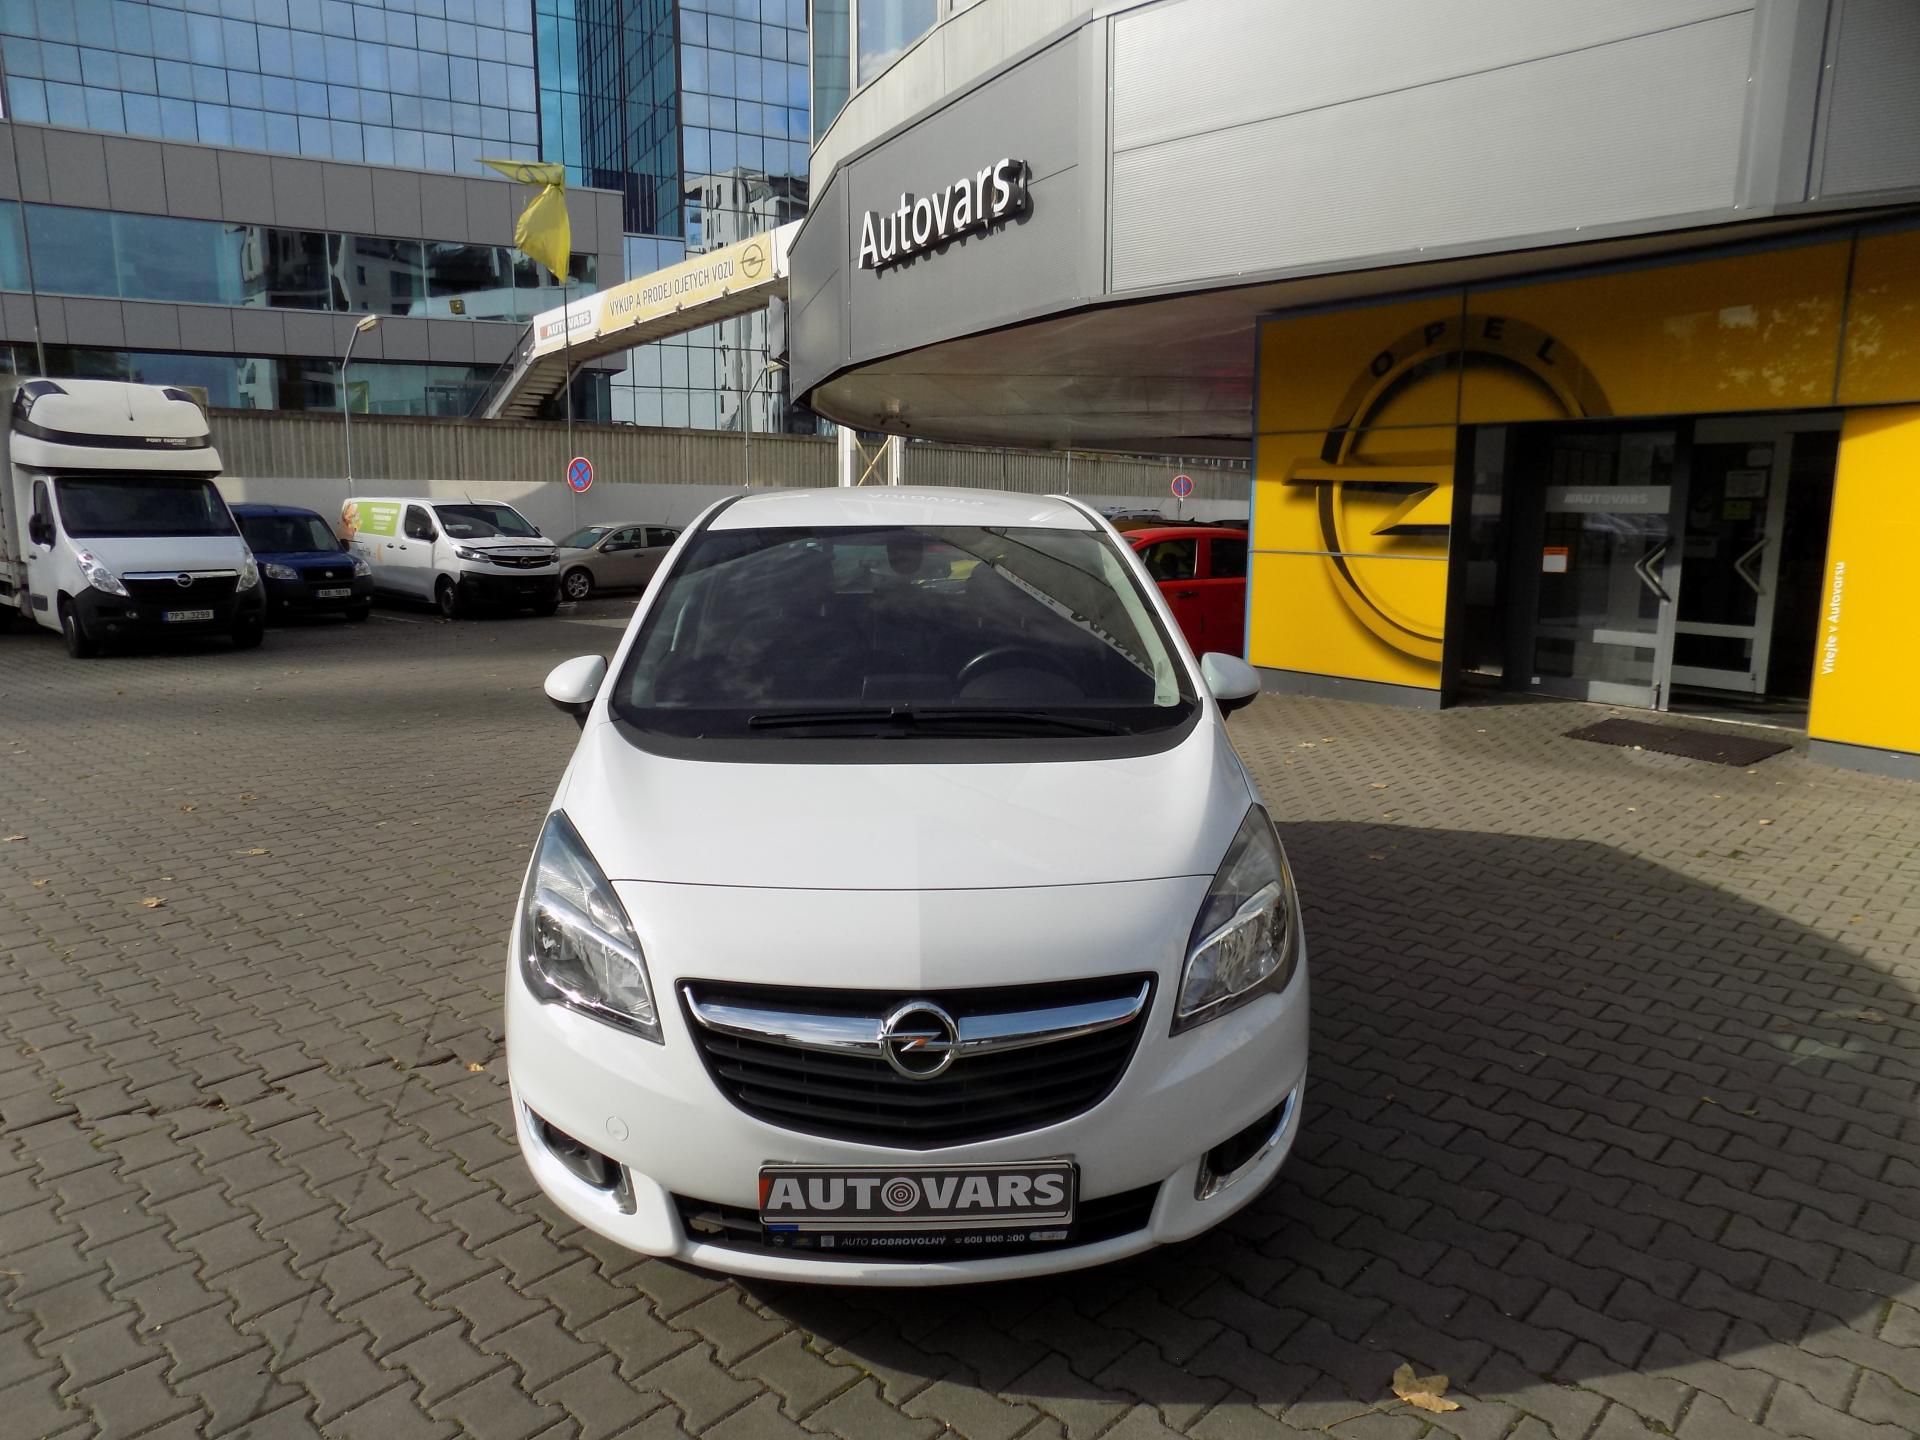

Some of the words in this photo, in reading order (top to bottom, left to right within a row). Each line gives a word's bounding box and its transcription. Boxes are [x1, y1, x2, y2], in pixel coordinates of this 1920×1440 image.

[858, 157, 1014, 270] Autovars
[636, 293, 642, 309] A
[642, 281, 673, 307] PRODEJ
[1369, 316, 1556, 378] OPEL
[1571, 493, 1649, 505] AUTOVARS
[1826, 561, 1845, 624] Autovarsu
[766, 1172, 1065, 1212] AUTOVARS
[841, 1237, 869, 1246] AUTO
